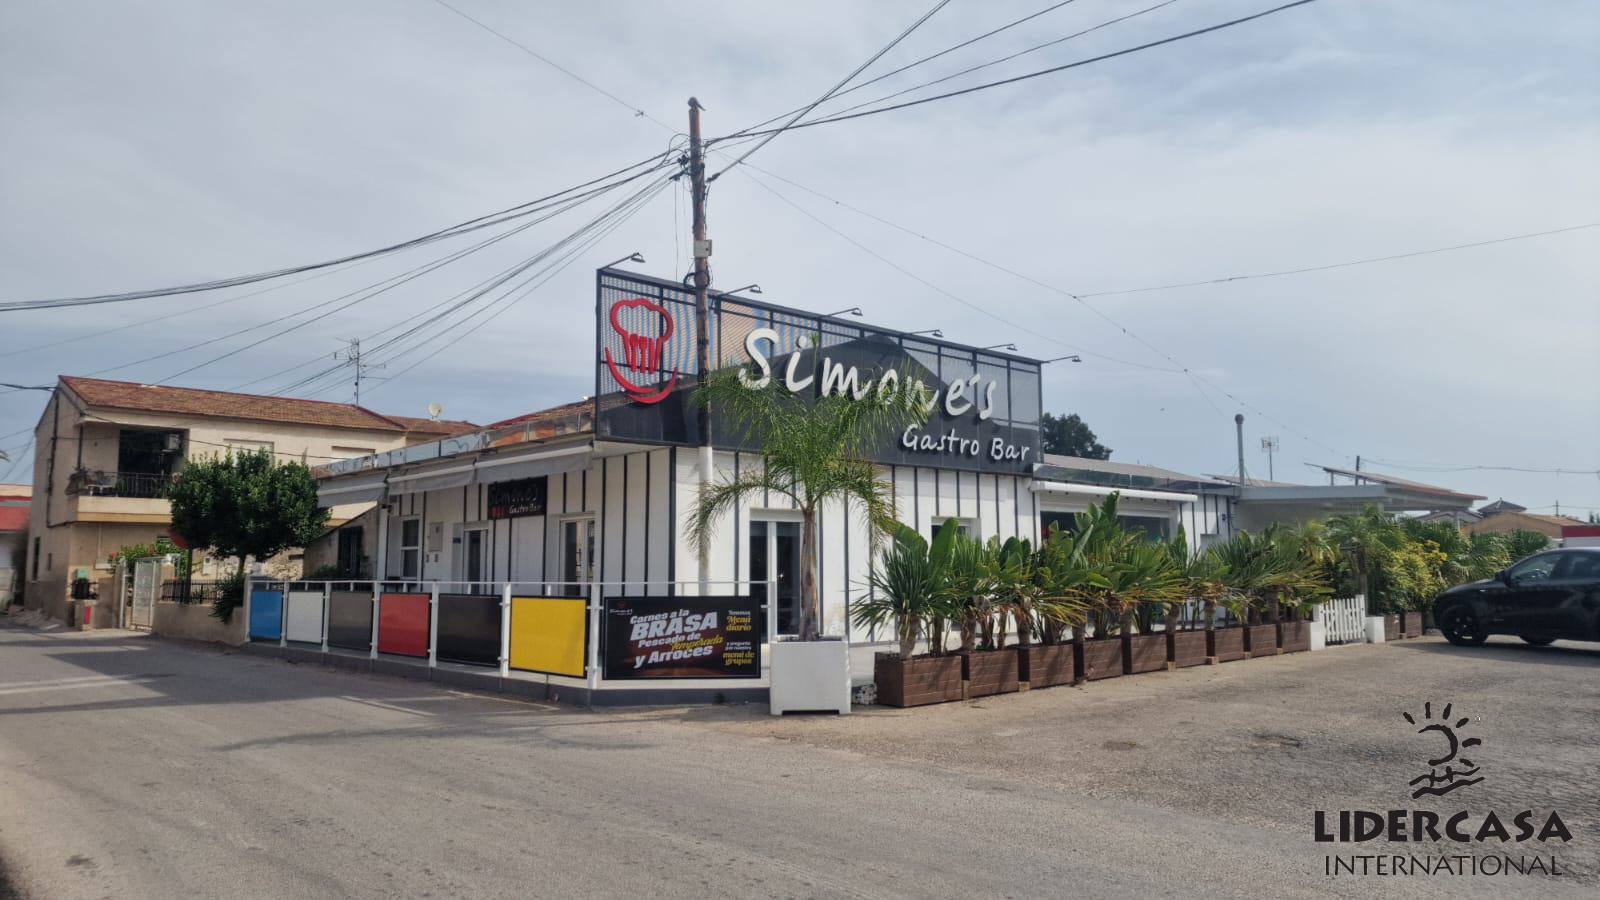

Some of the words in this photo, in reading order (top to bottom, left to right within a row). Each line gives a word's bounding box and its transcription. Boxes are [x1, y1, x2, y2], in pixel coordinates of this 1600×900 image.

[738, 327, 997, 420] Simone's
[902, 423, 979, 456] Gastro
[991, 437, 1030, 461] Bar
[630, 612, 668, 624] Carnes
[679, 608, 690, 616] la
[630, 612, 718, 641] BRASA
[726, 624, 752, 632] diario
[638, 634, 686, 648] Pescado
[687, 632, 701, 641] de
[633, 655, 646, 668] y
[648, 646, 714, 663] Arroces
